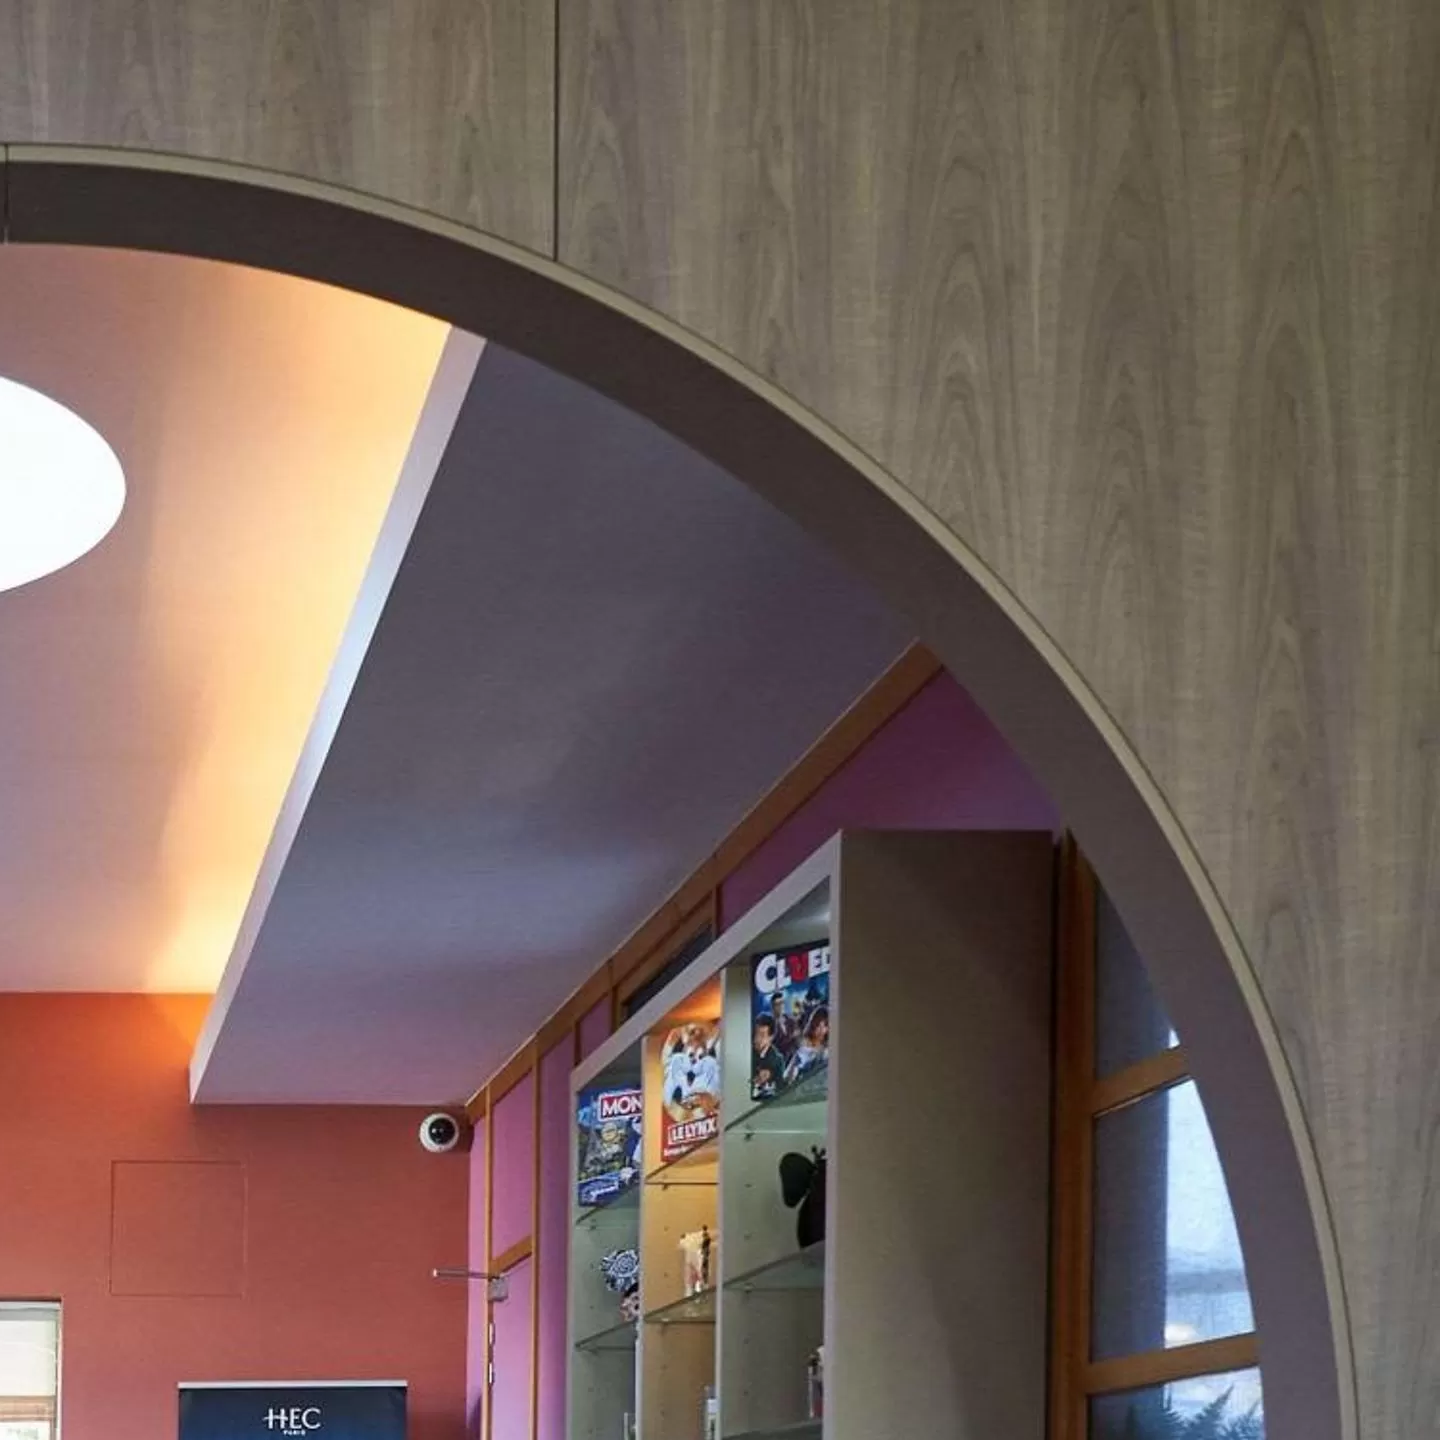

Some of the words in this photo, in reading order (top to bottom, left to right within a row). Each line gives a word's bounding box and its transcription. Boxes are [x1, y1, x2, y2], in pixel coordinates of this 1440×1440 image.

[671, 1126, 684, 1141] LE
[685, 1117, 717, 1138] LYNX
[263, 1407, 321, 1429] HEC
